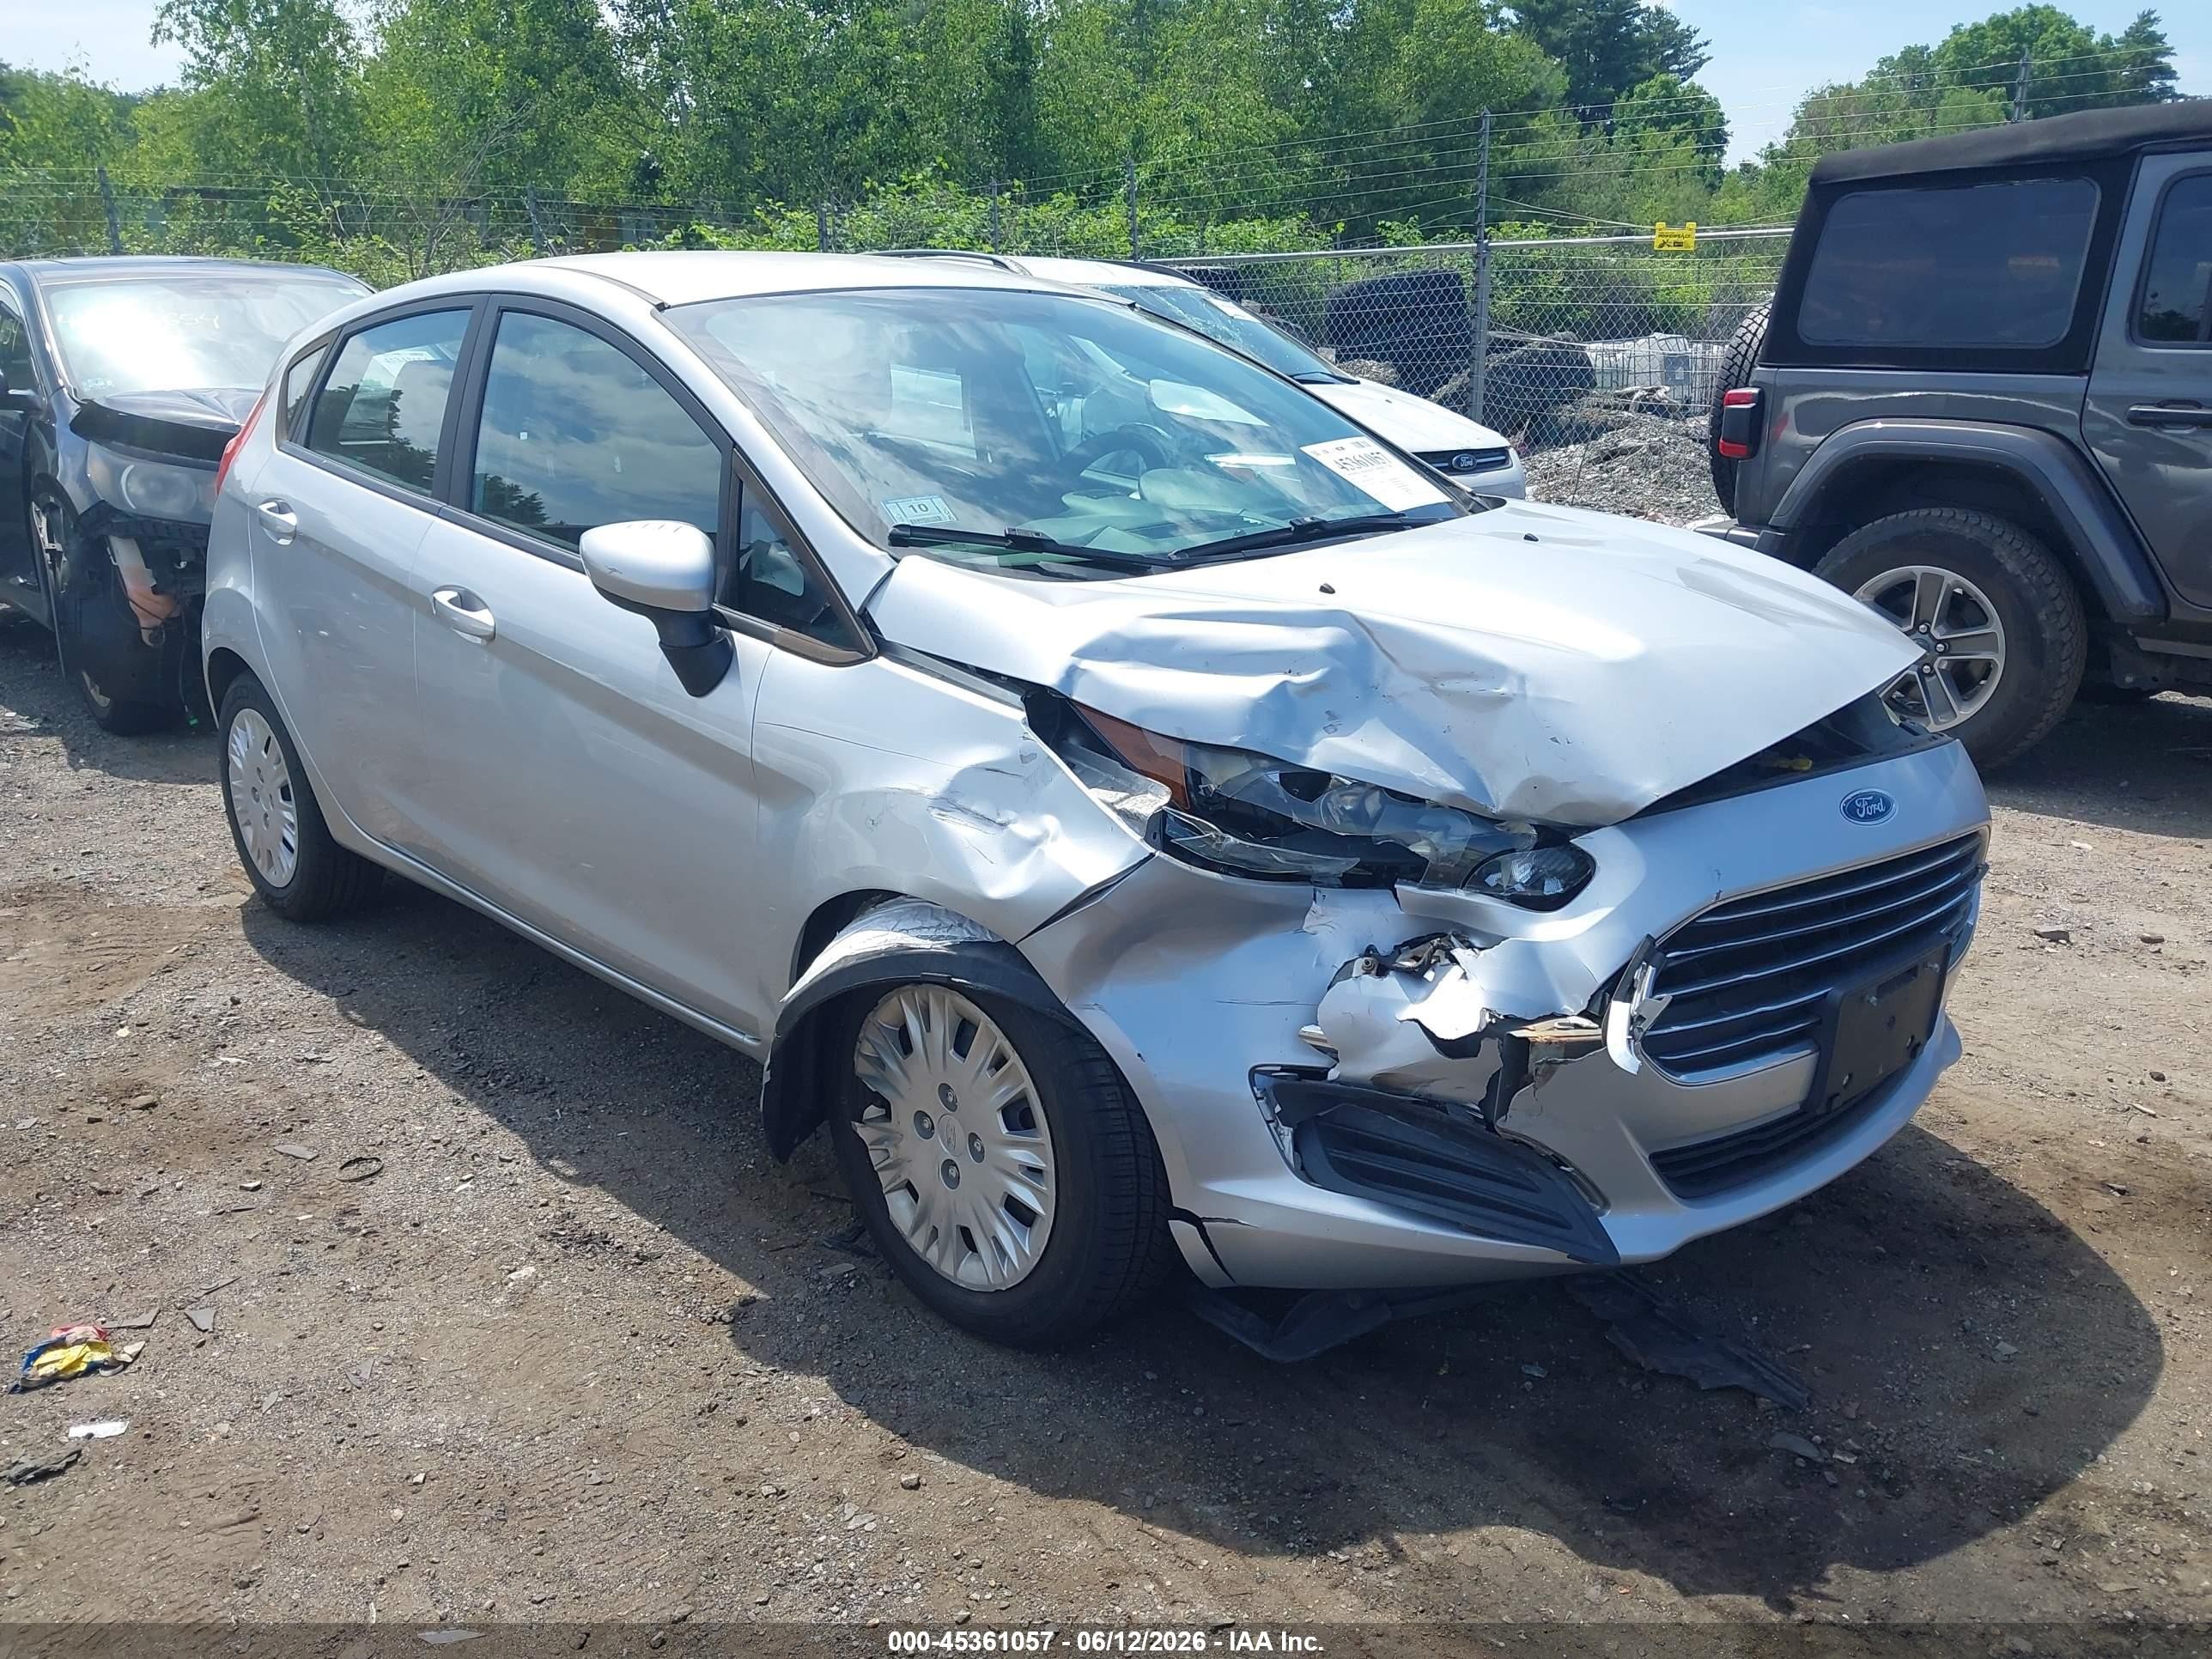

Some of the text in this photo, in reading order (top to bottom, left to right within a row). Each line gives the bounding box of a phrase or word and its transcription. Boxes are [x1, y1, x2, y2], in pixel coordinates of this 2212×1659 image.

[1334, 452, 1392, 471] 45361057
[908, 503, 929, 514] 10
[1855, 796, 1886, 818] Ford
